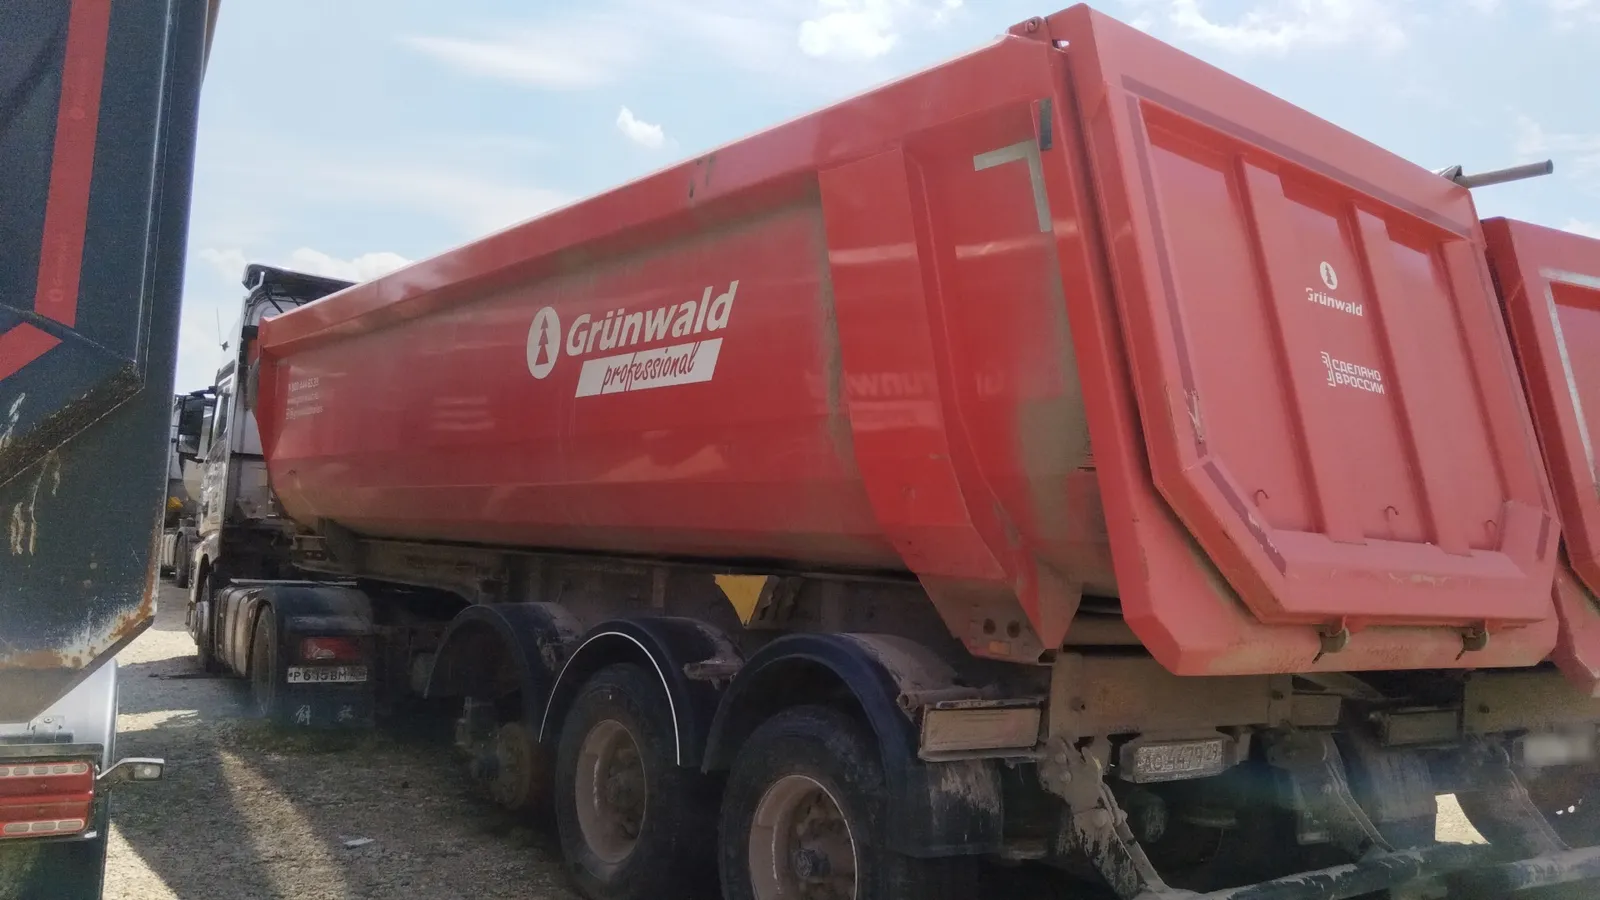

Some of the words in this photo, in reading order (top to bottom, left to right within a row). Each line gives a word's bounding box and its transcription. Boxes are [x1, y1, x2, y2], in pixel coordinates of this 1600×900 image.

[566, 280, 740, 356] Grünwald
[600, 341, 701, 394] professional
[1332, 359, 1382, 381] СДЕЛАНО
